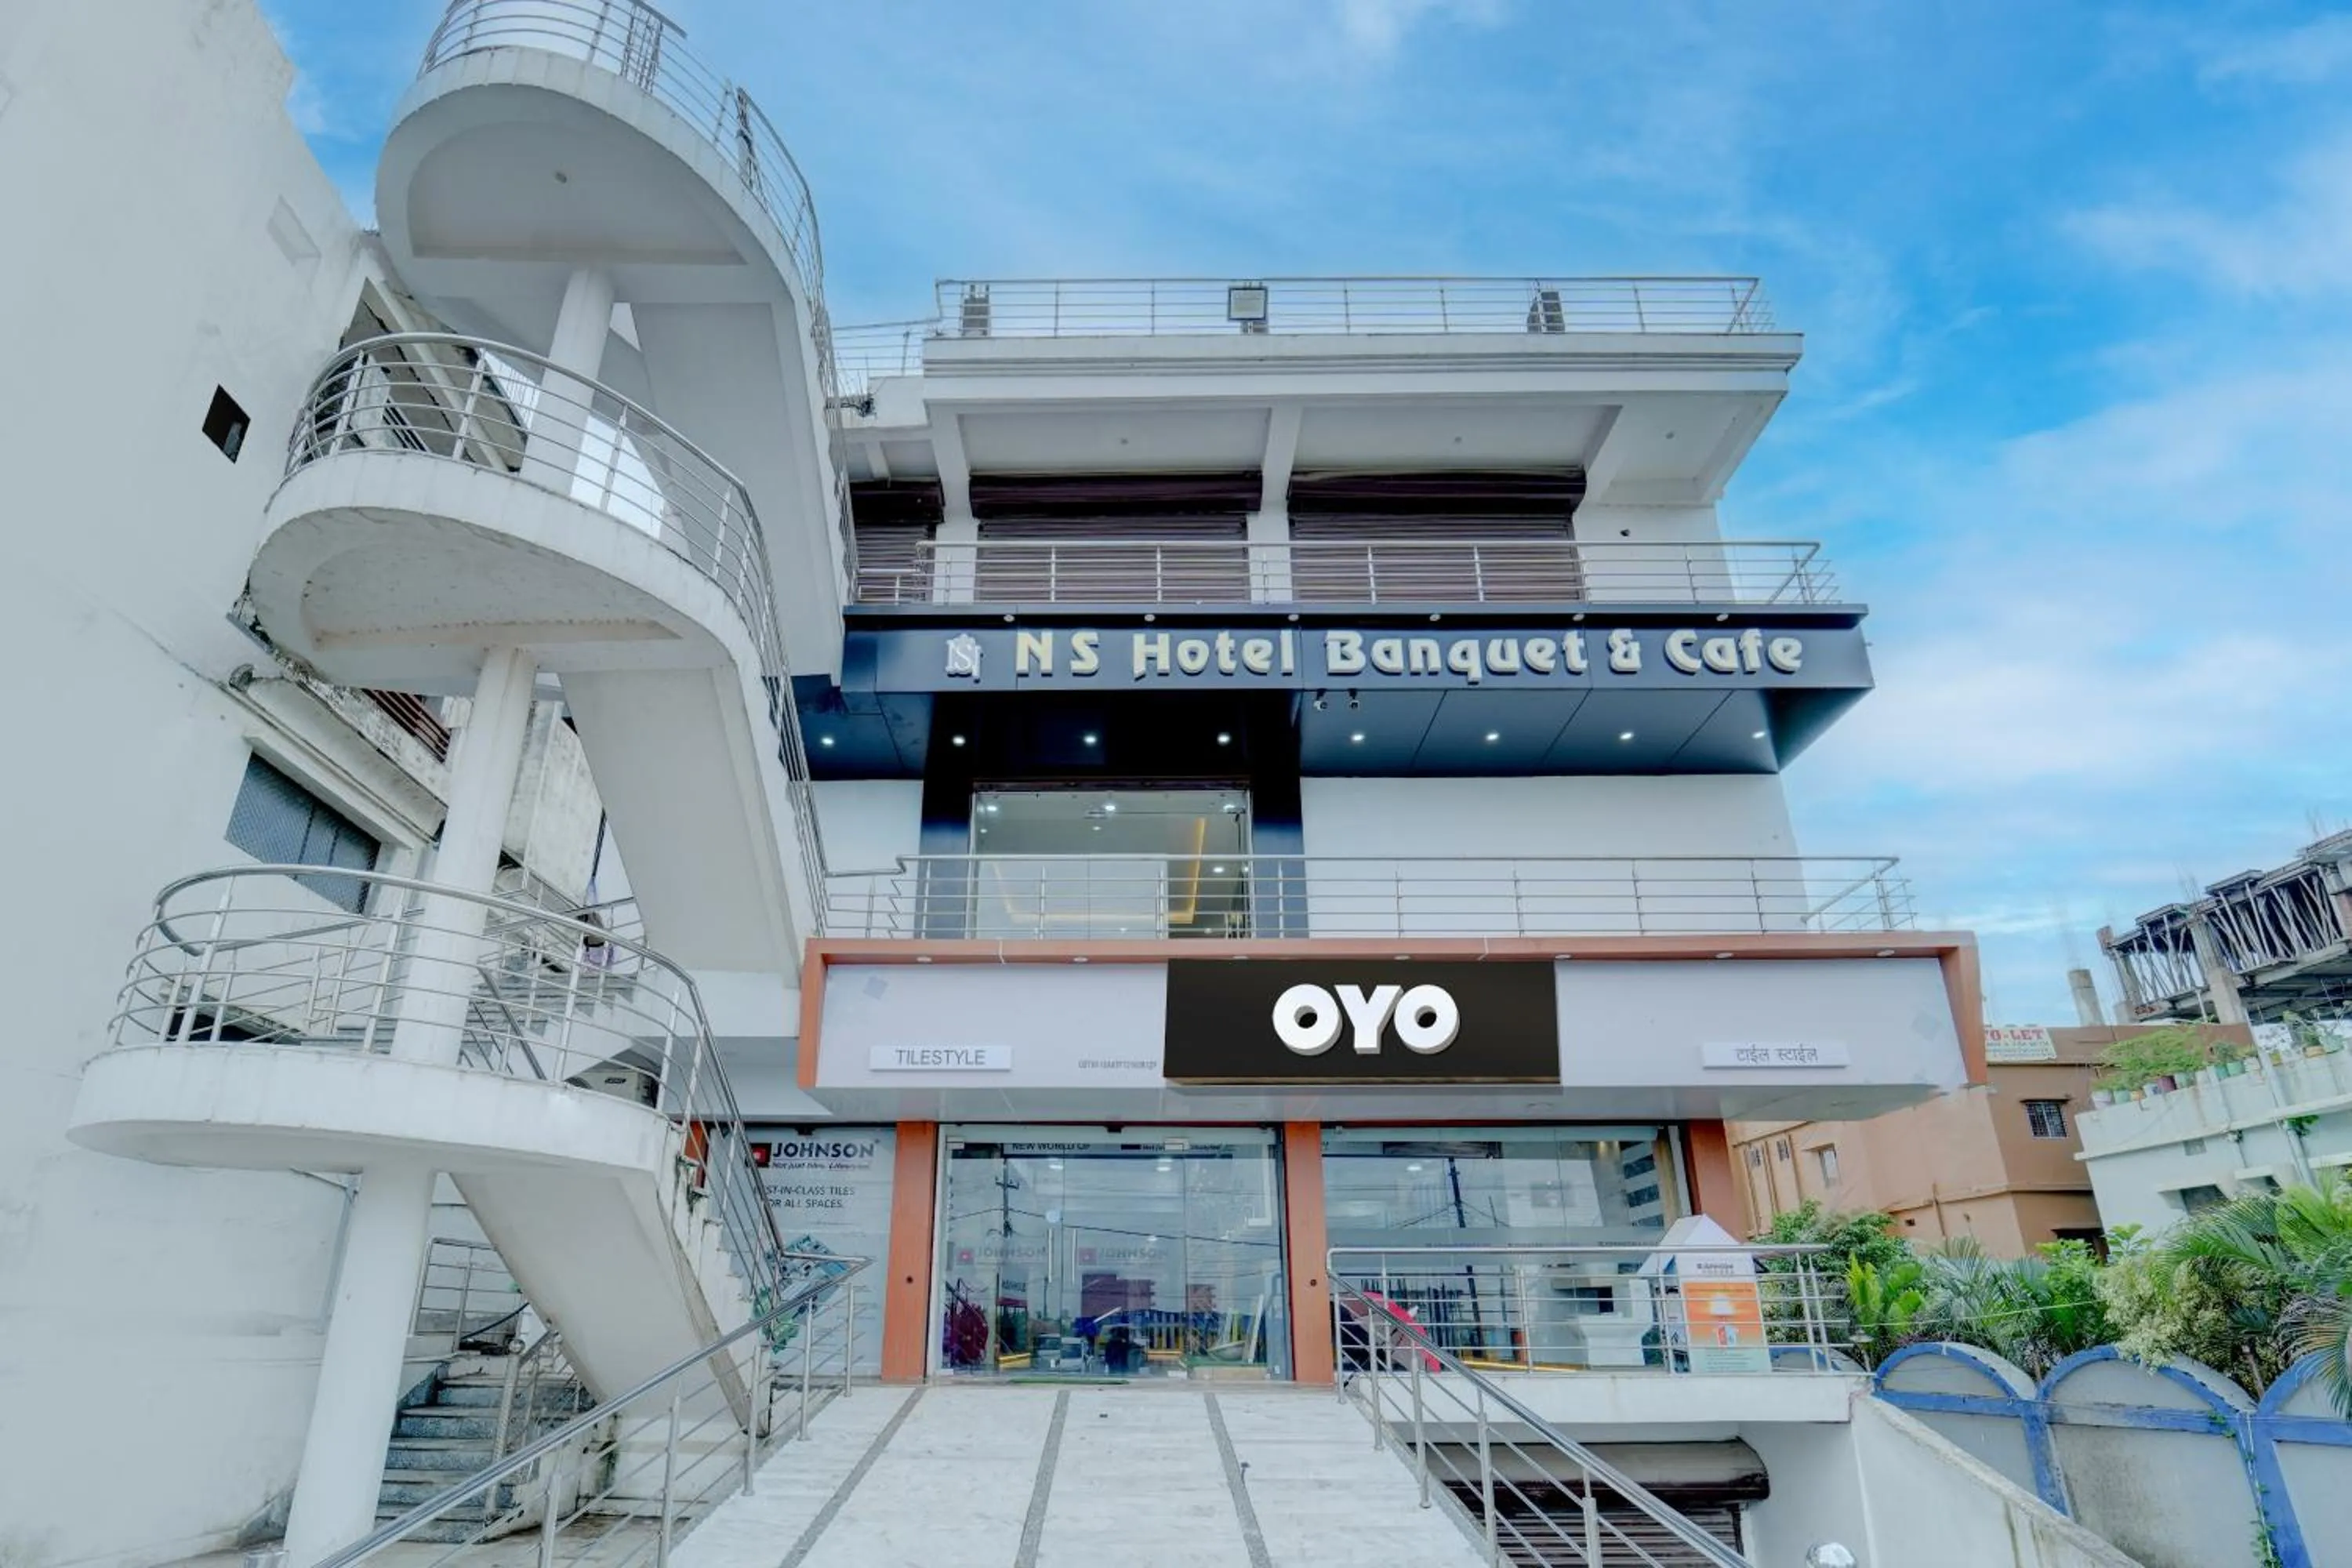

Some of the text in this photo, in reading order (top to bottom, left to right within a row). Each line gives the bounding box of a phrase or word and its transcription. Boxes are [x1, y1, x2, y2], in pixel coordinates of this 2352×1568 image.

[1016, 627, 1803, 684] NS Hotel Banquet & Cafe
[1272, 983, 1461, 1056] OYO
[895, 1049, 986, 1065] TILESTYLE
[772, 1142, 874, 1158] JOHNSON
[829, 1185, 855, 1196] TILES
